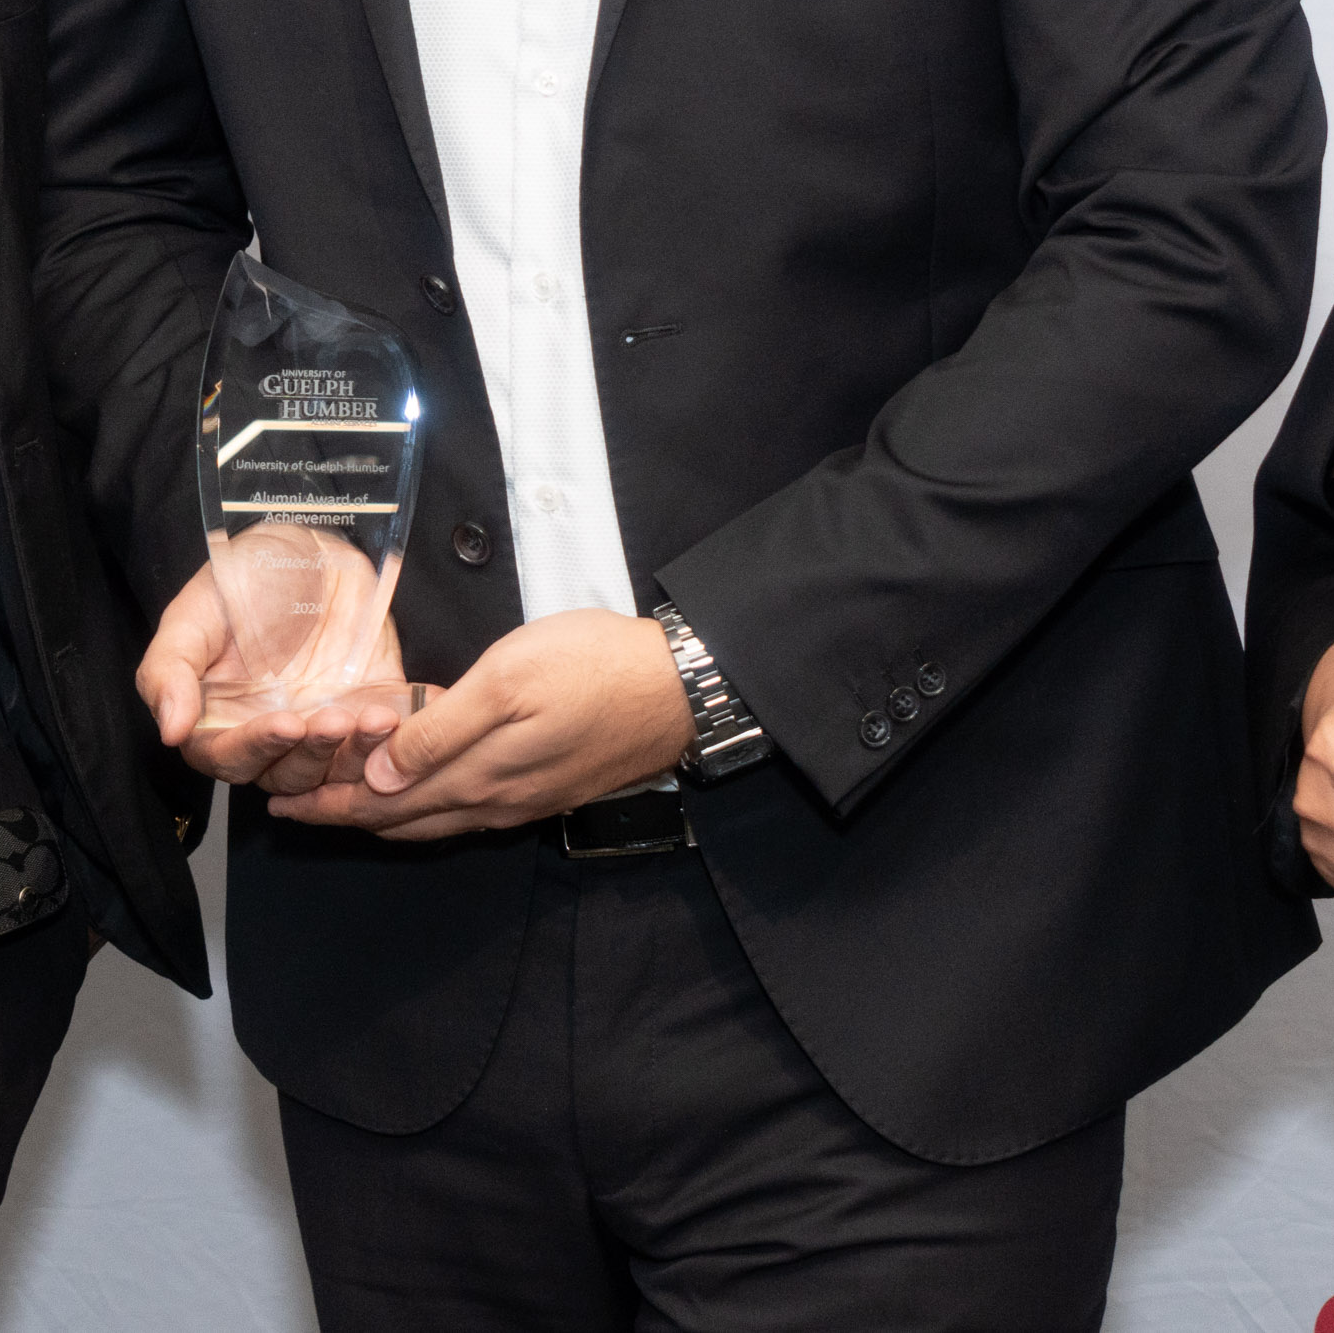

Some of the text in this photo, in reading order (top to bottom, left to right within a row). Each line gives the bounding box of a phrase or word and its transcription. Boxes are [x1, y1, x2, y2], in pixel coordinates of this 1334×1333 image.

[282, 369, 346, 378] UNIVERSITY OF
[263, 375, 354, 396] GUELPH
[282, 400, 378, 419] HUMBER
[236, 459, 288, 472] University
[291, 460, 303, 470] of
[252, 491, 369, 506] Alumni Award of
[264, 512, 356, 525] Achievement
[292, 602, 323, 614] 2024
